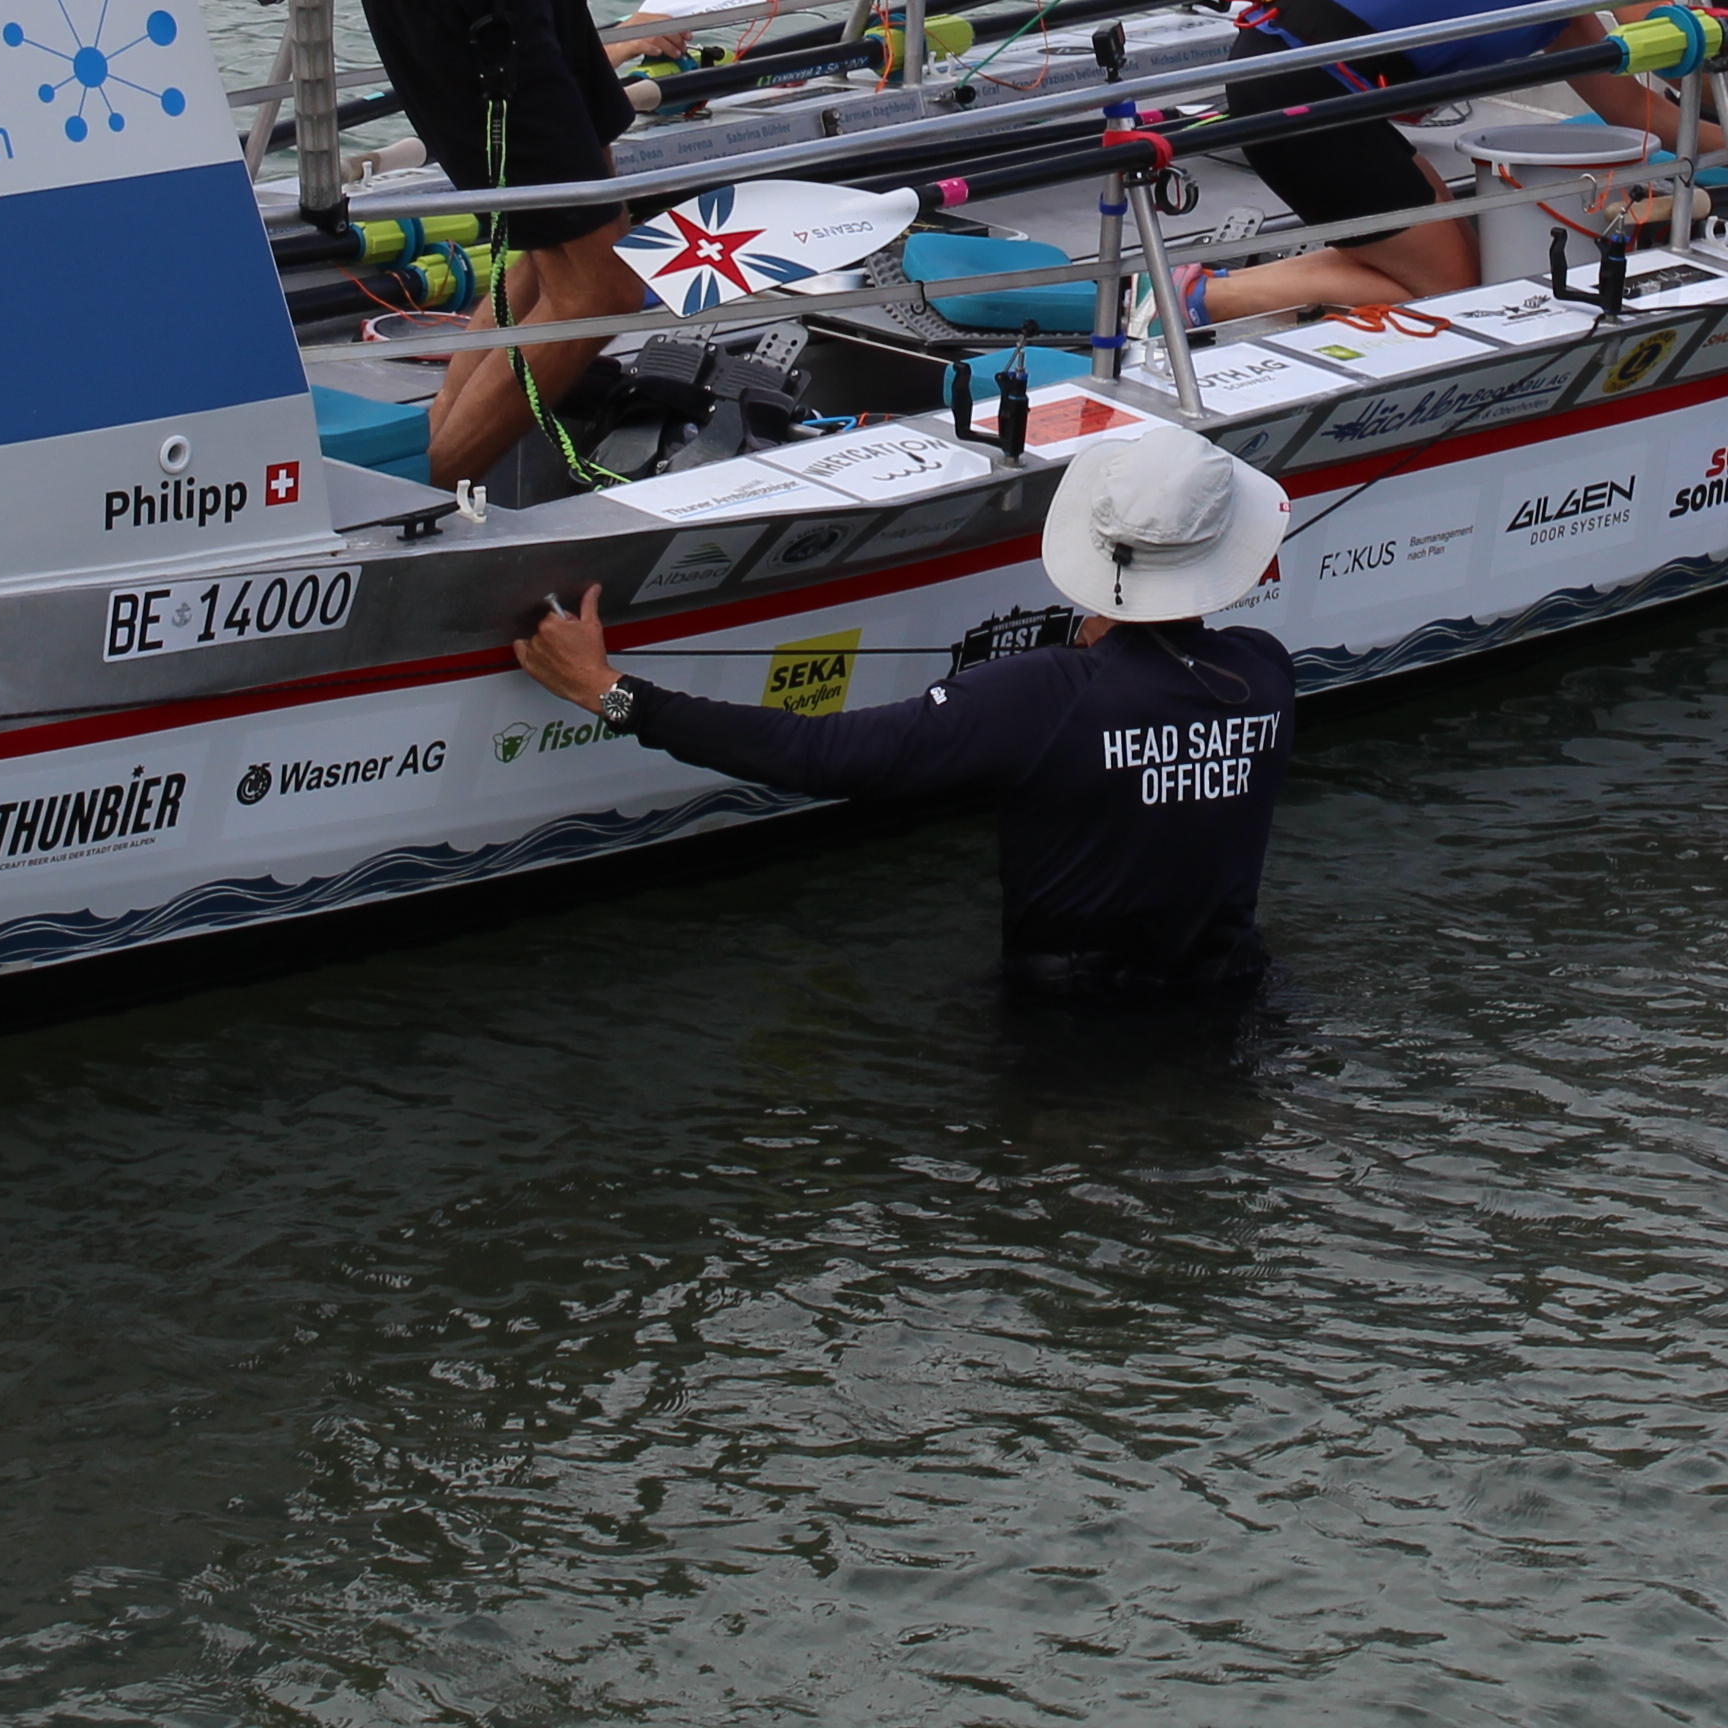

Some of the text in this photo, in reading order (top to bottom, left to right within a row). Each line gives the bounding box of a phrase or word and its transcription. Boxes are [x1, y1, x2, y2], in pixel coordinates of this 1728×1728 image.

[1245, 358, 1291, 376] AG
[104, 474, 248, 532] Philipp
[1505, 474, 1637, 533] GILGEN
[1408, 524, 1474, 548] Baumanagement
[1529, 508, 1631, 546] DOOR SYSTEMS
[1406, 543, 1446, 562] nach Plan
[645, 562, 732, 590] Albaad
[1263, 587, 1281, 601] AG
[107, 570, 353, 658] BE 14000
[770, 653, 848, 694] SEKA
[1102, 710, 1282, 770] HEAD SAFETY
[277, 739, 447, 795] Wasner AG
[1141, 757, 1252, 806] OFFICER
[27, 856, 49, 868] BEER
[49, 853, 68, 864] AUS
[68, 849, 85, 860] DER
[85, 844, 112, 858] STADT
[112, 842, 129, 852] DER
[129, 836, 157, 850] ALPEN
